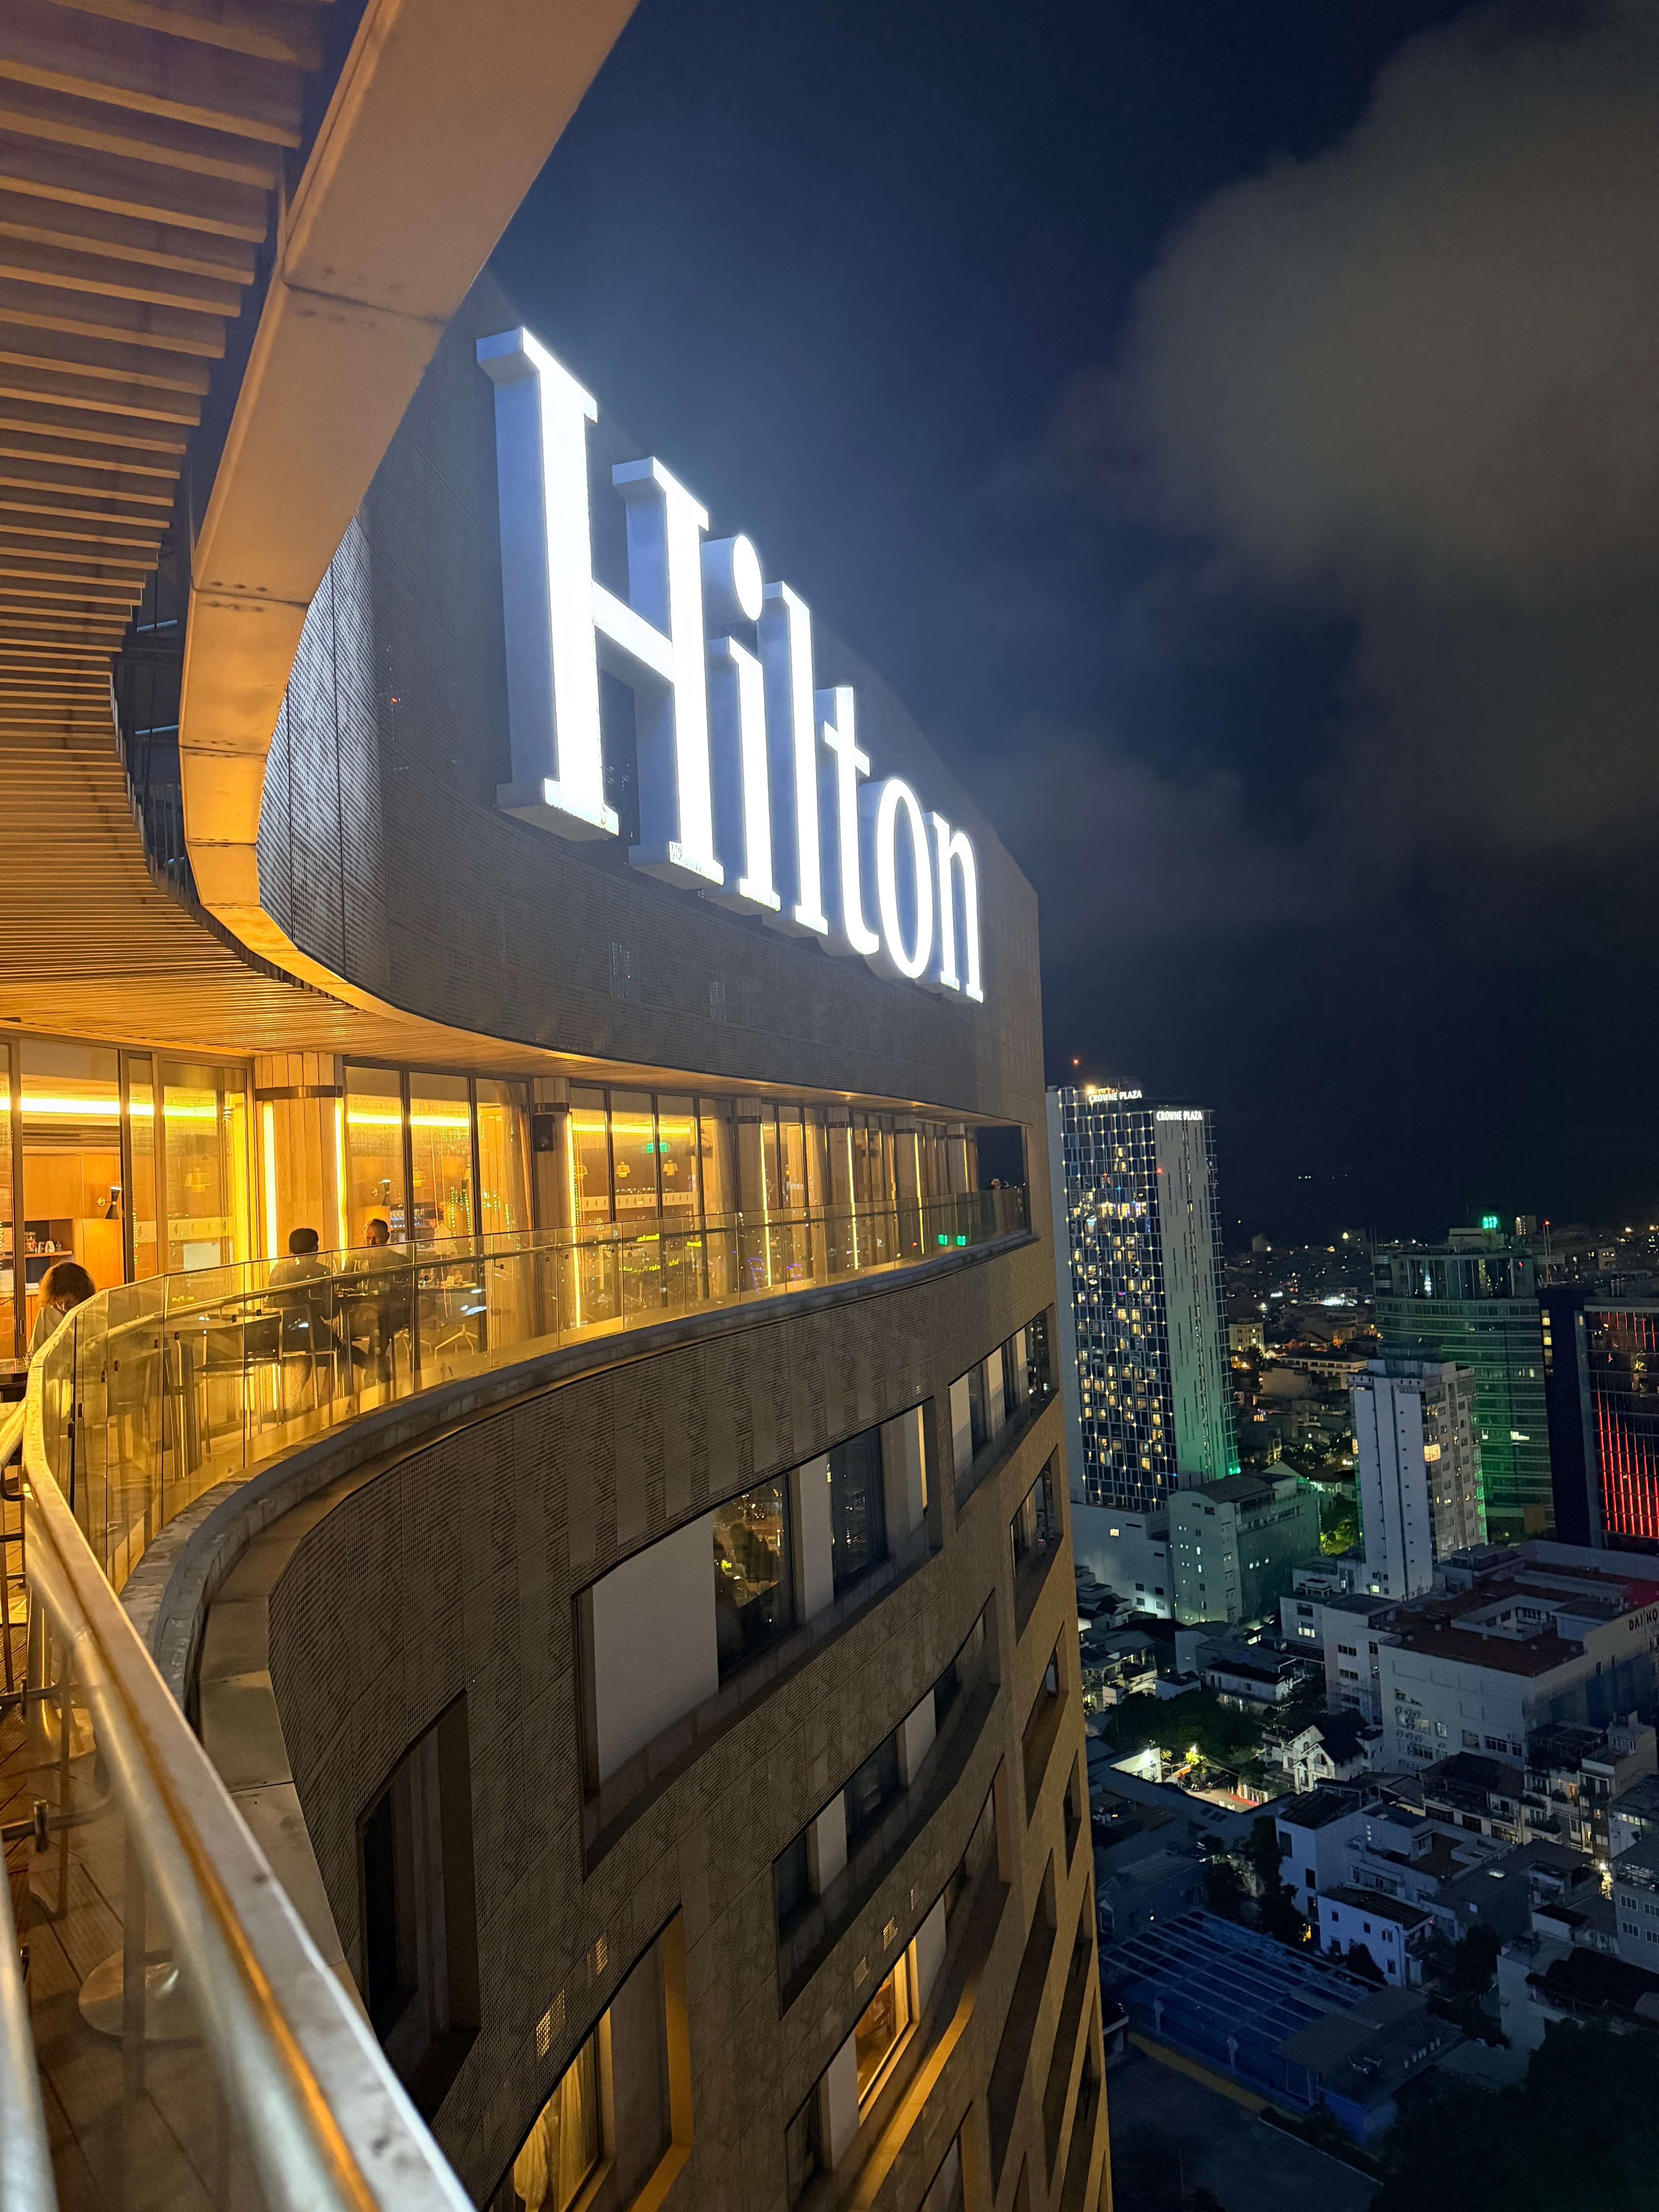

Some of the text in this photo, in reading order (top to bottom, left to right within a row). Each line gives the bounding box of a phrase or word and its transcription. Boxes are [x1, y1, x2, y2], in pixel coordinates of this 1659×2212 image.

[479, 327, 983, 1003] Hilton
[1089, 1090, 1142, 1103] CROWNE PLAZA
[1156, 1111, 1203, 1121] CROWNE PLAZA
